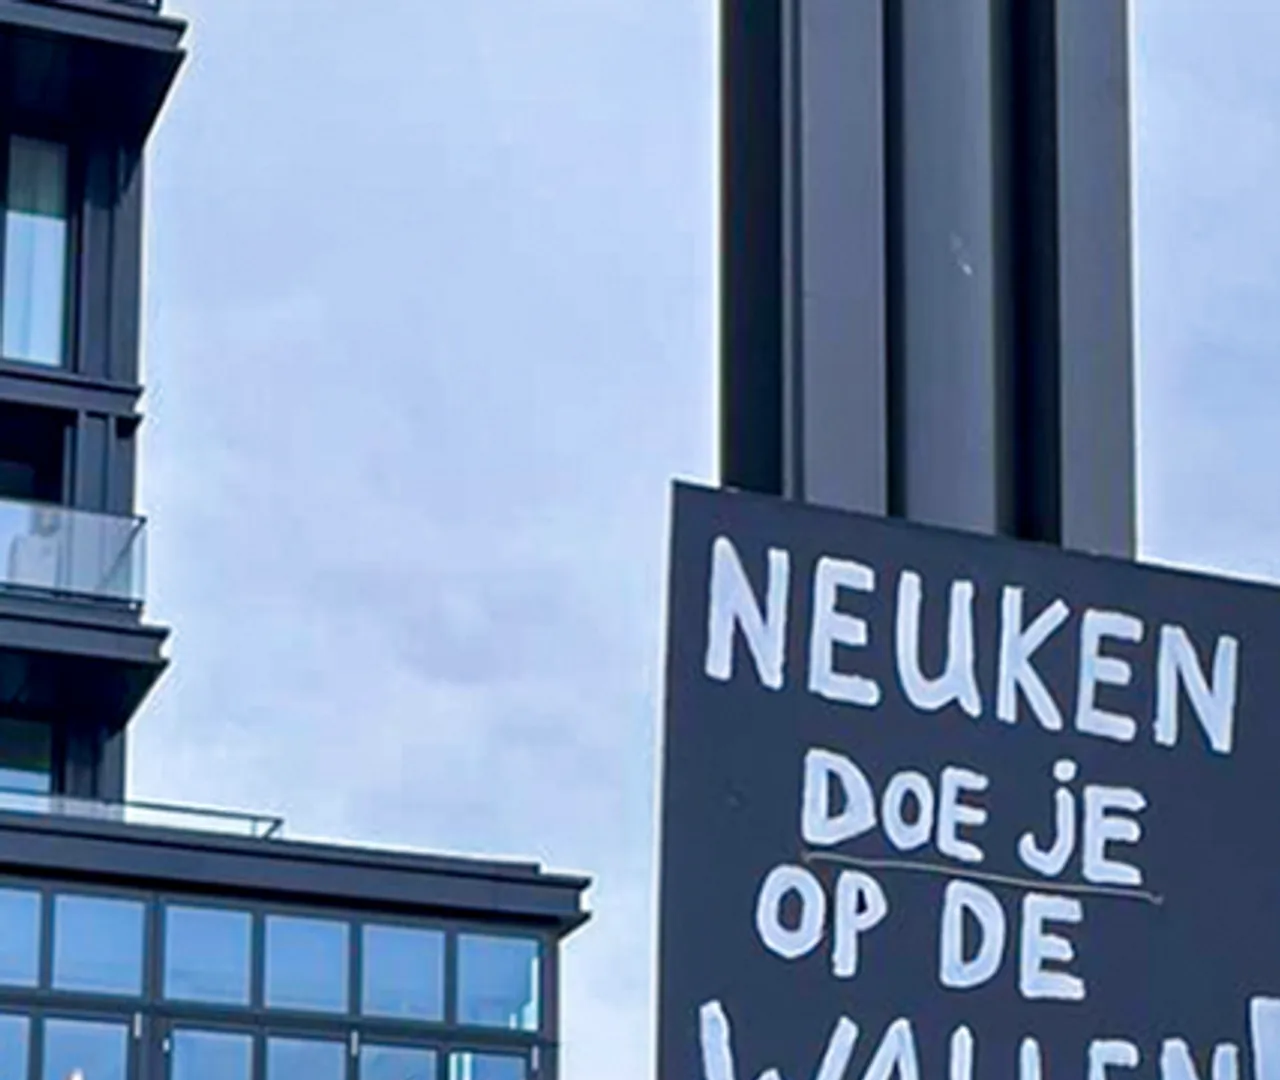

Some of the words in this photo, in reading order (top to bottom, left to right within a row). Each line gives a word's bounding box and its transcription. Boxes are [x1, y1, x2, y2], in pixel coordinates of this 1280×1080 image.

[704, 535, 1239, 754] NEUKEN
[800, 747, 989, 863] DOE
[756, 863, 888, 977] OP
[939, 879, 1085, 1000] DE
